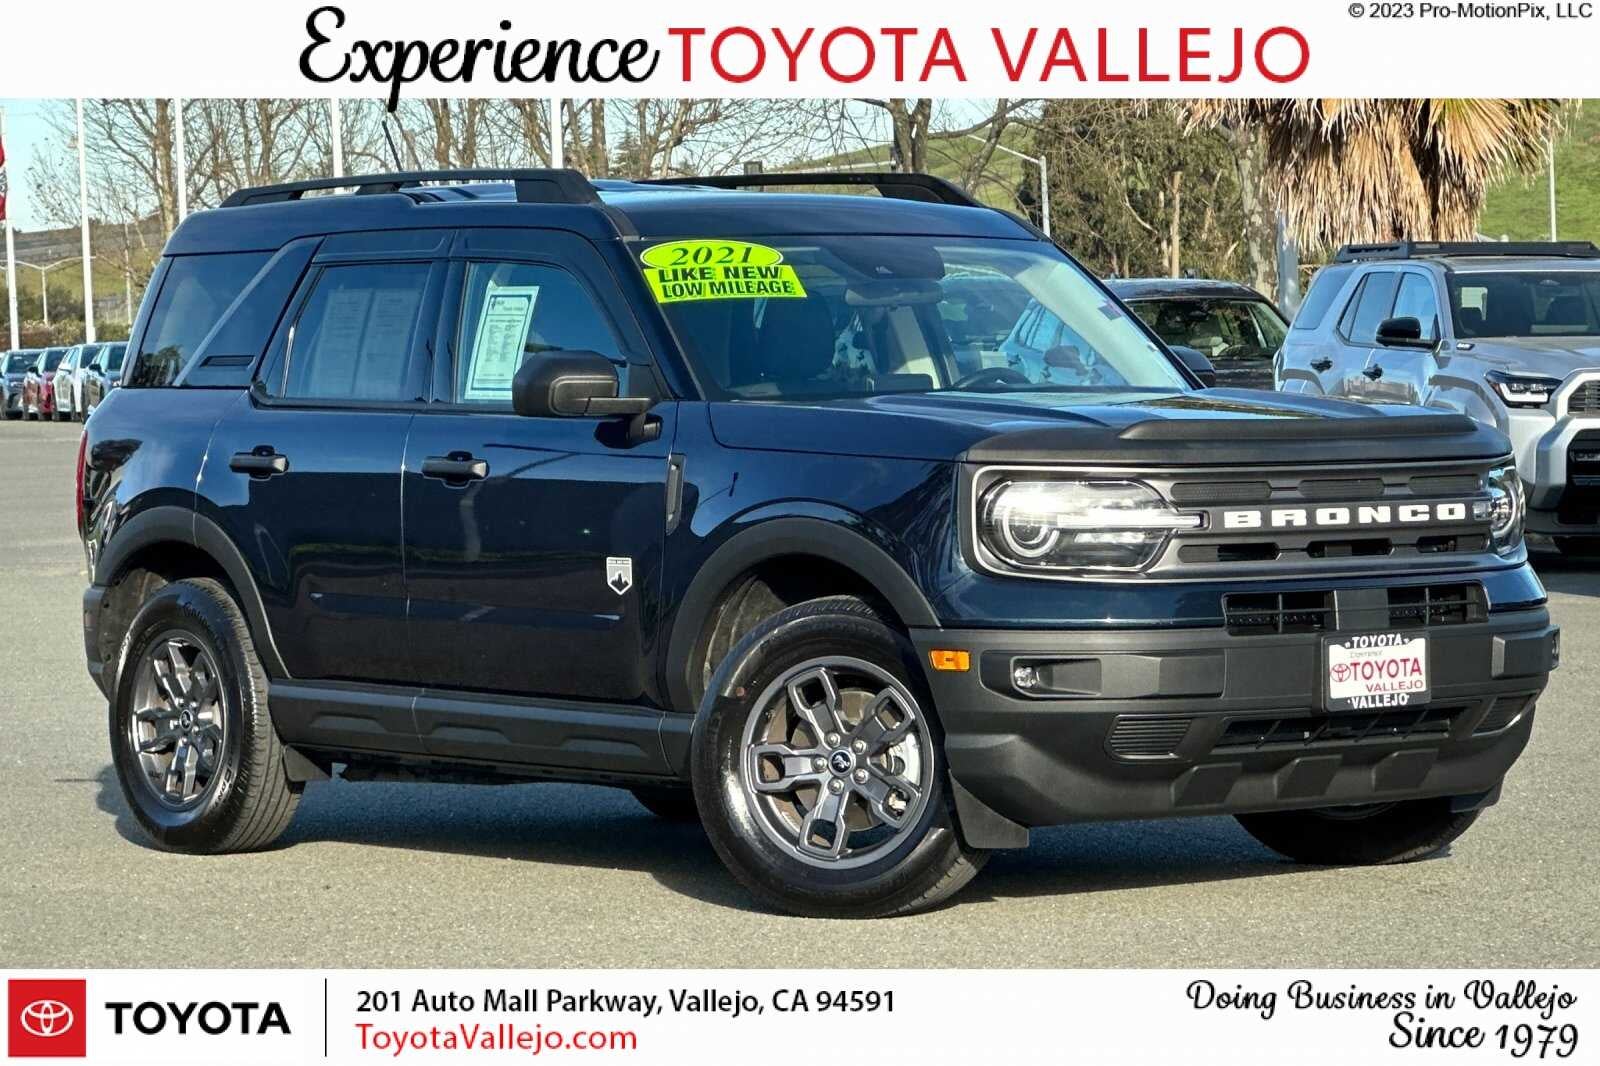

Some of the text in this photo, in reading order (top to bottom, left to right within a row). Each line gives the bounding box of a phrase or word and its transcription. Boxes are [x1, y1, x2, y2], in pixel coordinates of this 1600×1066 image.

[671, 246, 753, 265] 2021
[658, 265, 782, 282] LIKE NEW
[662, 280, 795, 298] LOW MILEAGE
[1223, 503, 1466, 529] BRONCO
[1352, 633, 1403, 648] TOYOTA
[1350, 657, 1422, 681] TOYOTA
[1366, 679, 1423, 692] VALLEJO
[1352, 693, 1408, 709] VALLEJO
